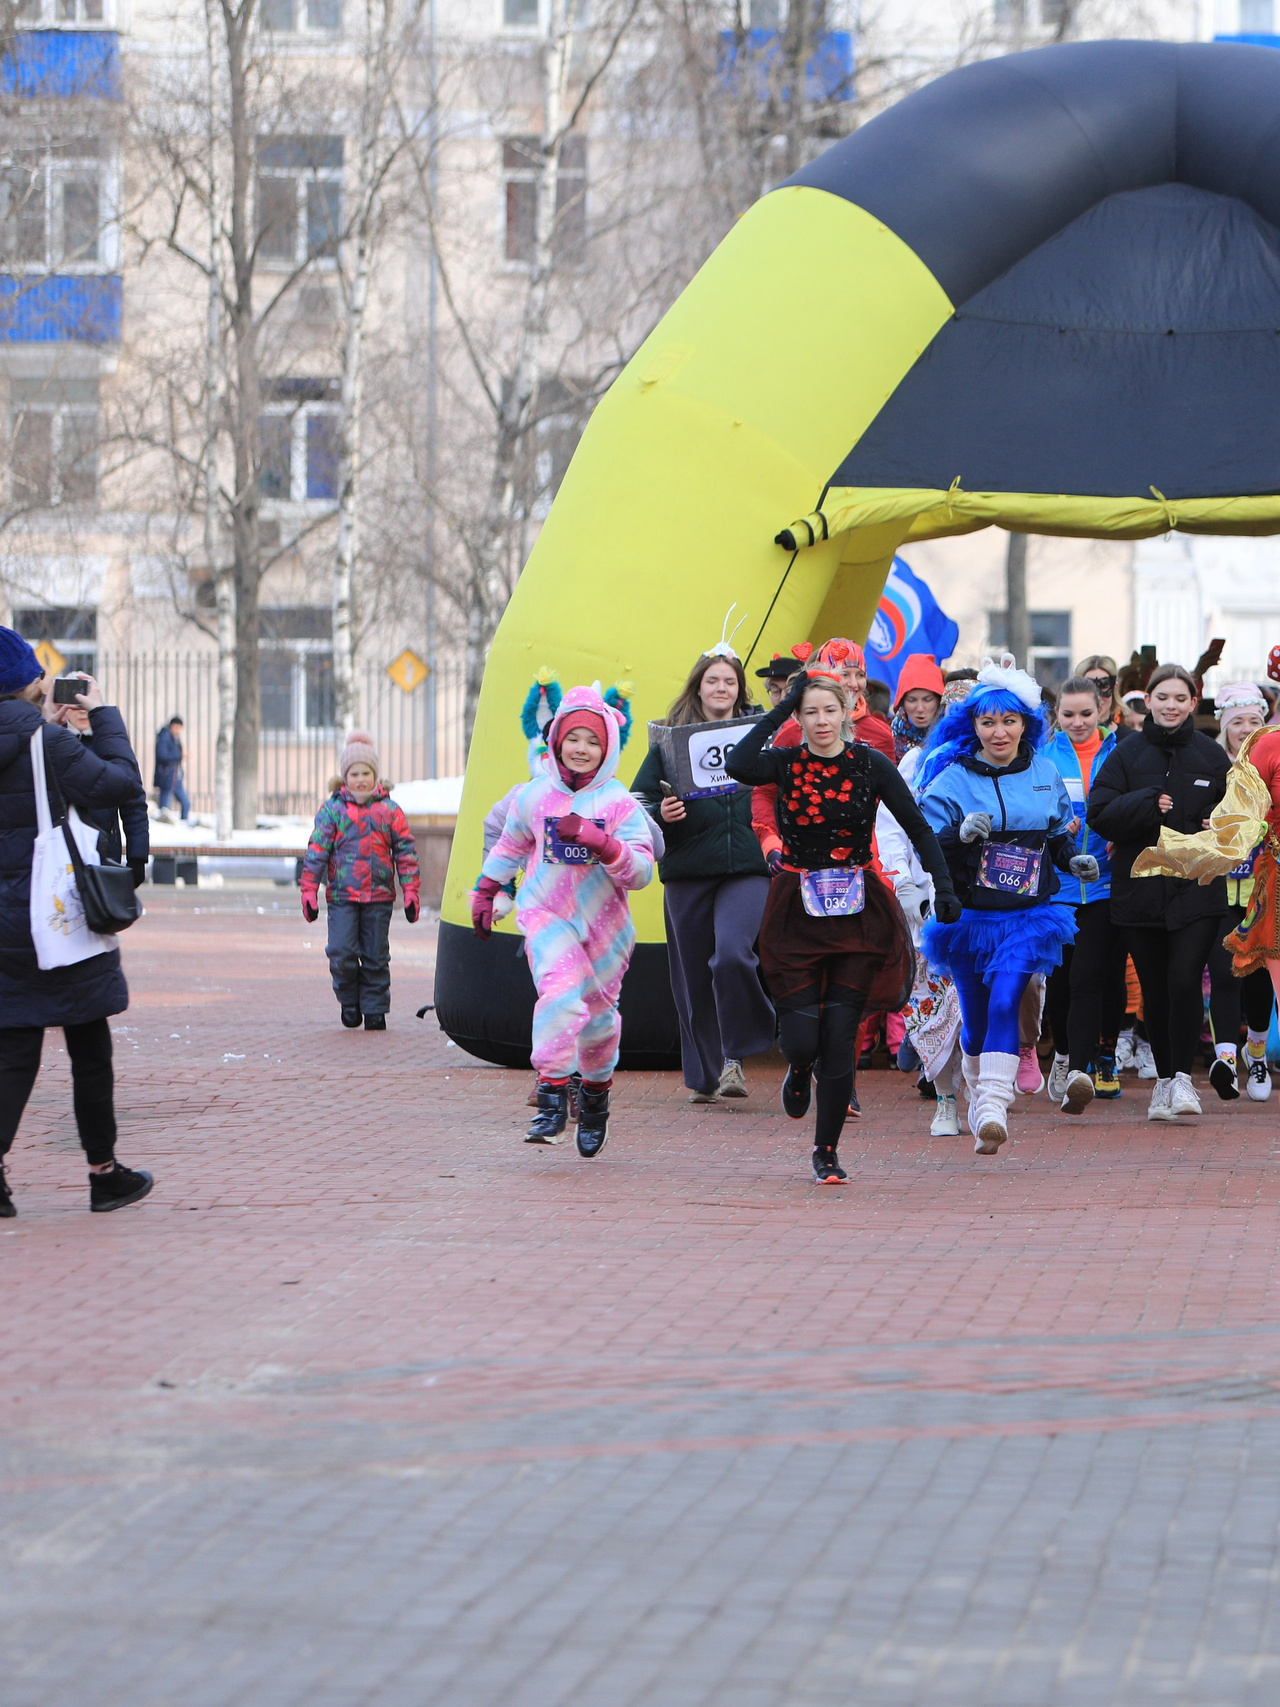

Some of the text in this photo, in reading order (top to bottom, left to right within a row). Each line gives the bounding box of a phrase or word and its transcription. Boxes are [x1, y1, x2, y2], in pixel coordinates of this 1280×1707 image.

[710, 774, 733, 783] Хим
[564, 846, 588, 858] 003
[1012, 865, 1026, 873] 2023
[998, 872, 1021, 887] 066
[824, 897, 848, 909] 036
